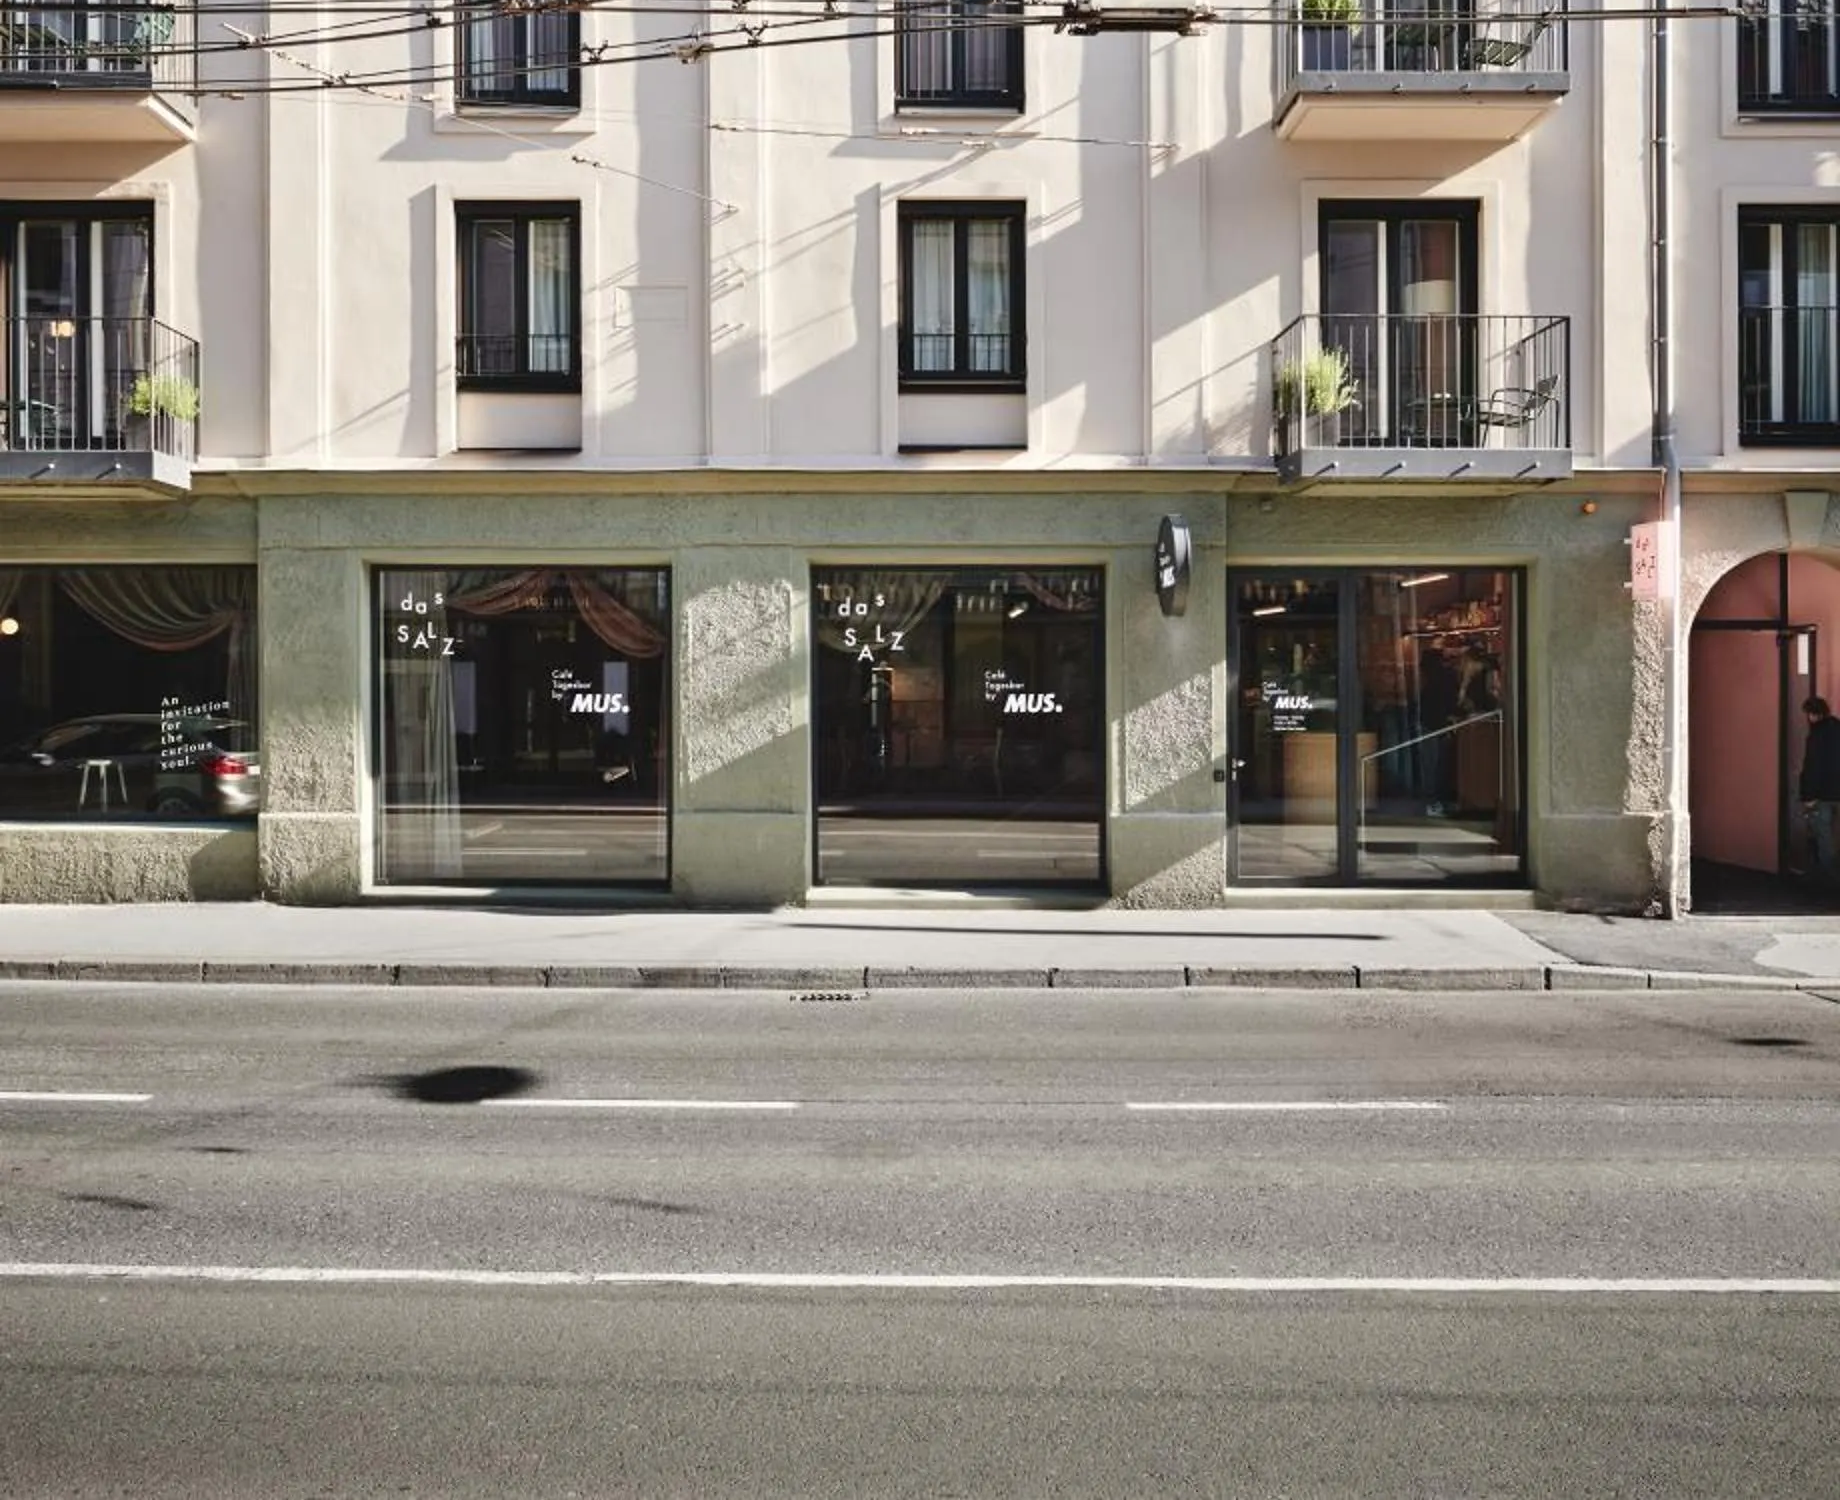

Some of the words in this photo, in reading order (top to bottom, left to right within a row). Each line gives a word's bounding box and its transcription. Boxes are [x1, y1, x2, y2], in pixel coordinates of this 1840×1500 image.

[401, 591, 443, 614] das
[838, 594, 885, 616] das
[397, 621, 455, 655] SALZ
[844, 623, 904, 661] SALZ
[161, 696, 179, 707] An
[161, 701, 230, 720] invitation
[570, 693, 630, 714] MUS.
[1003, 692, 1063, 713] MUS.
[1274, 695, 1313, 709] MUS.
[161, 721, 183, 733] for
[161, 733, 183, 745] the
[161, 741, 213, 757] curious
